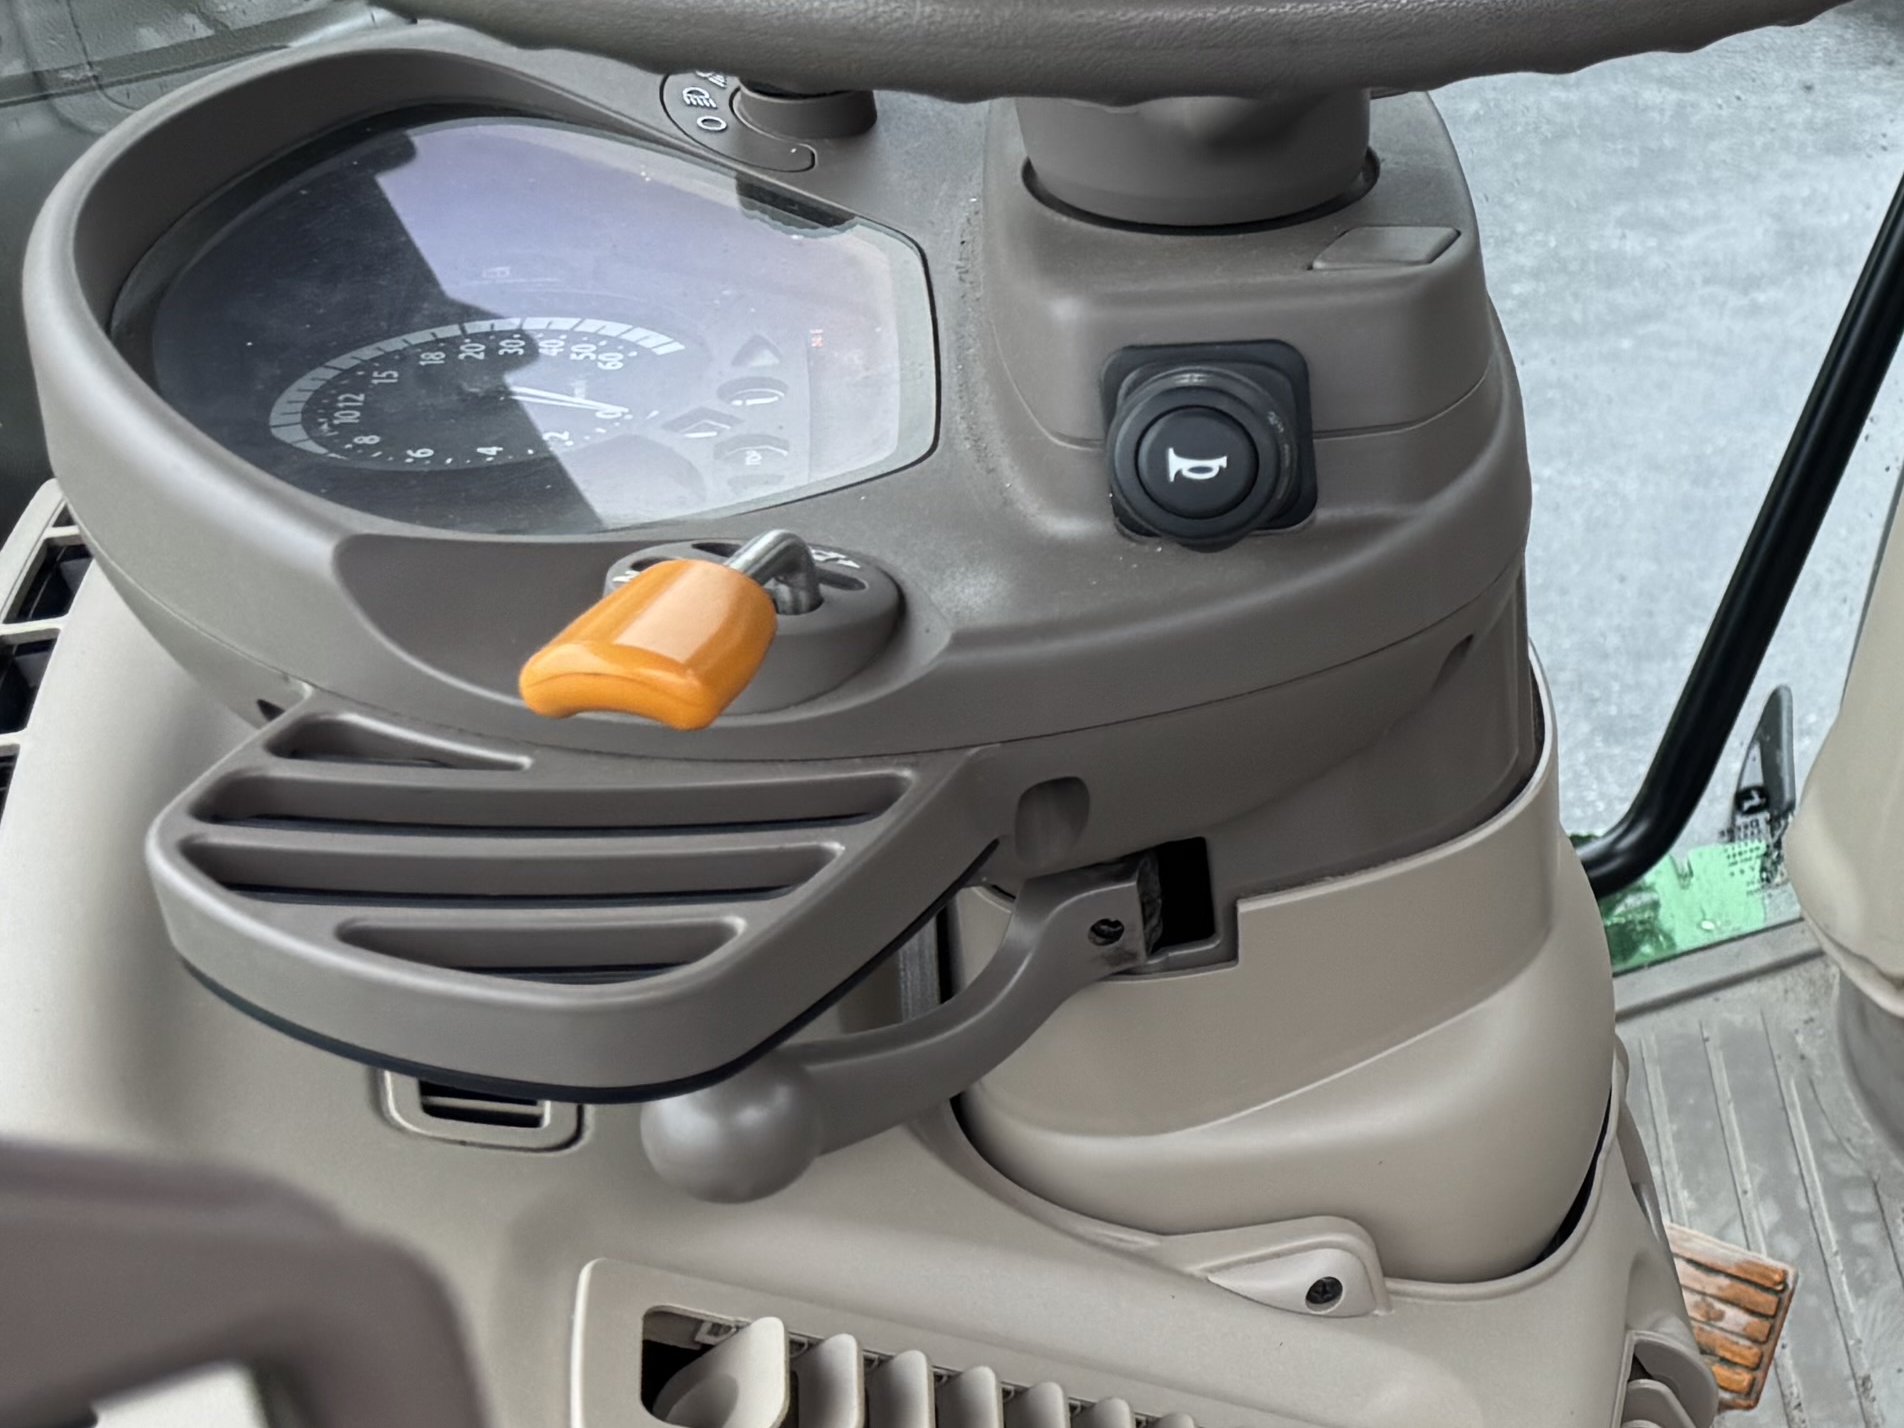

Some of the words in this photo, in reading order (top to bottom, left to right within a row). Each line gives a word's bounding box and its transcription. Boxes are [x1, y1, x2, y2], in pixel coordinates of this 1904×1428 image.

[458, 342, 486, 360] 20
[498, 339, 526, 356] 30
[539, 338, 565, 355] 40
[570, 343, 597, 361] 50
[419, 351, 445, 366] 18
[597, 352, 624, 370] 60
[372, 368, 399, 386] 15
[338, 392, 365, 408] 12
[333, 410, 361, 425] 10
[354, 434, 380, 445] 8
[543, 431, 570, 442] 2
[407, 448, 434, 458] 6
[476, 445, 503, 456] 4
